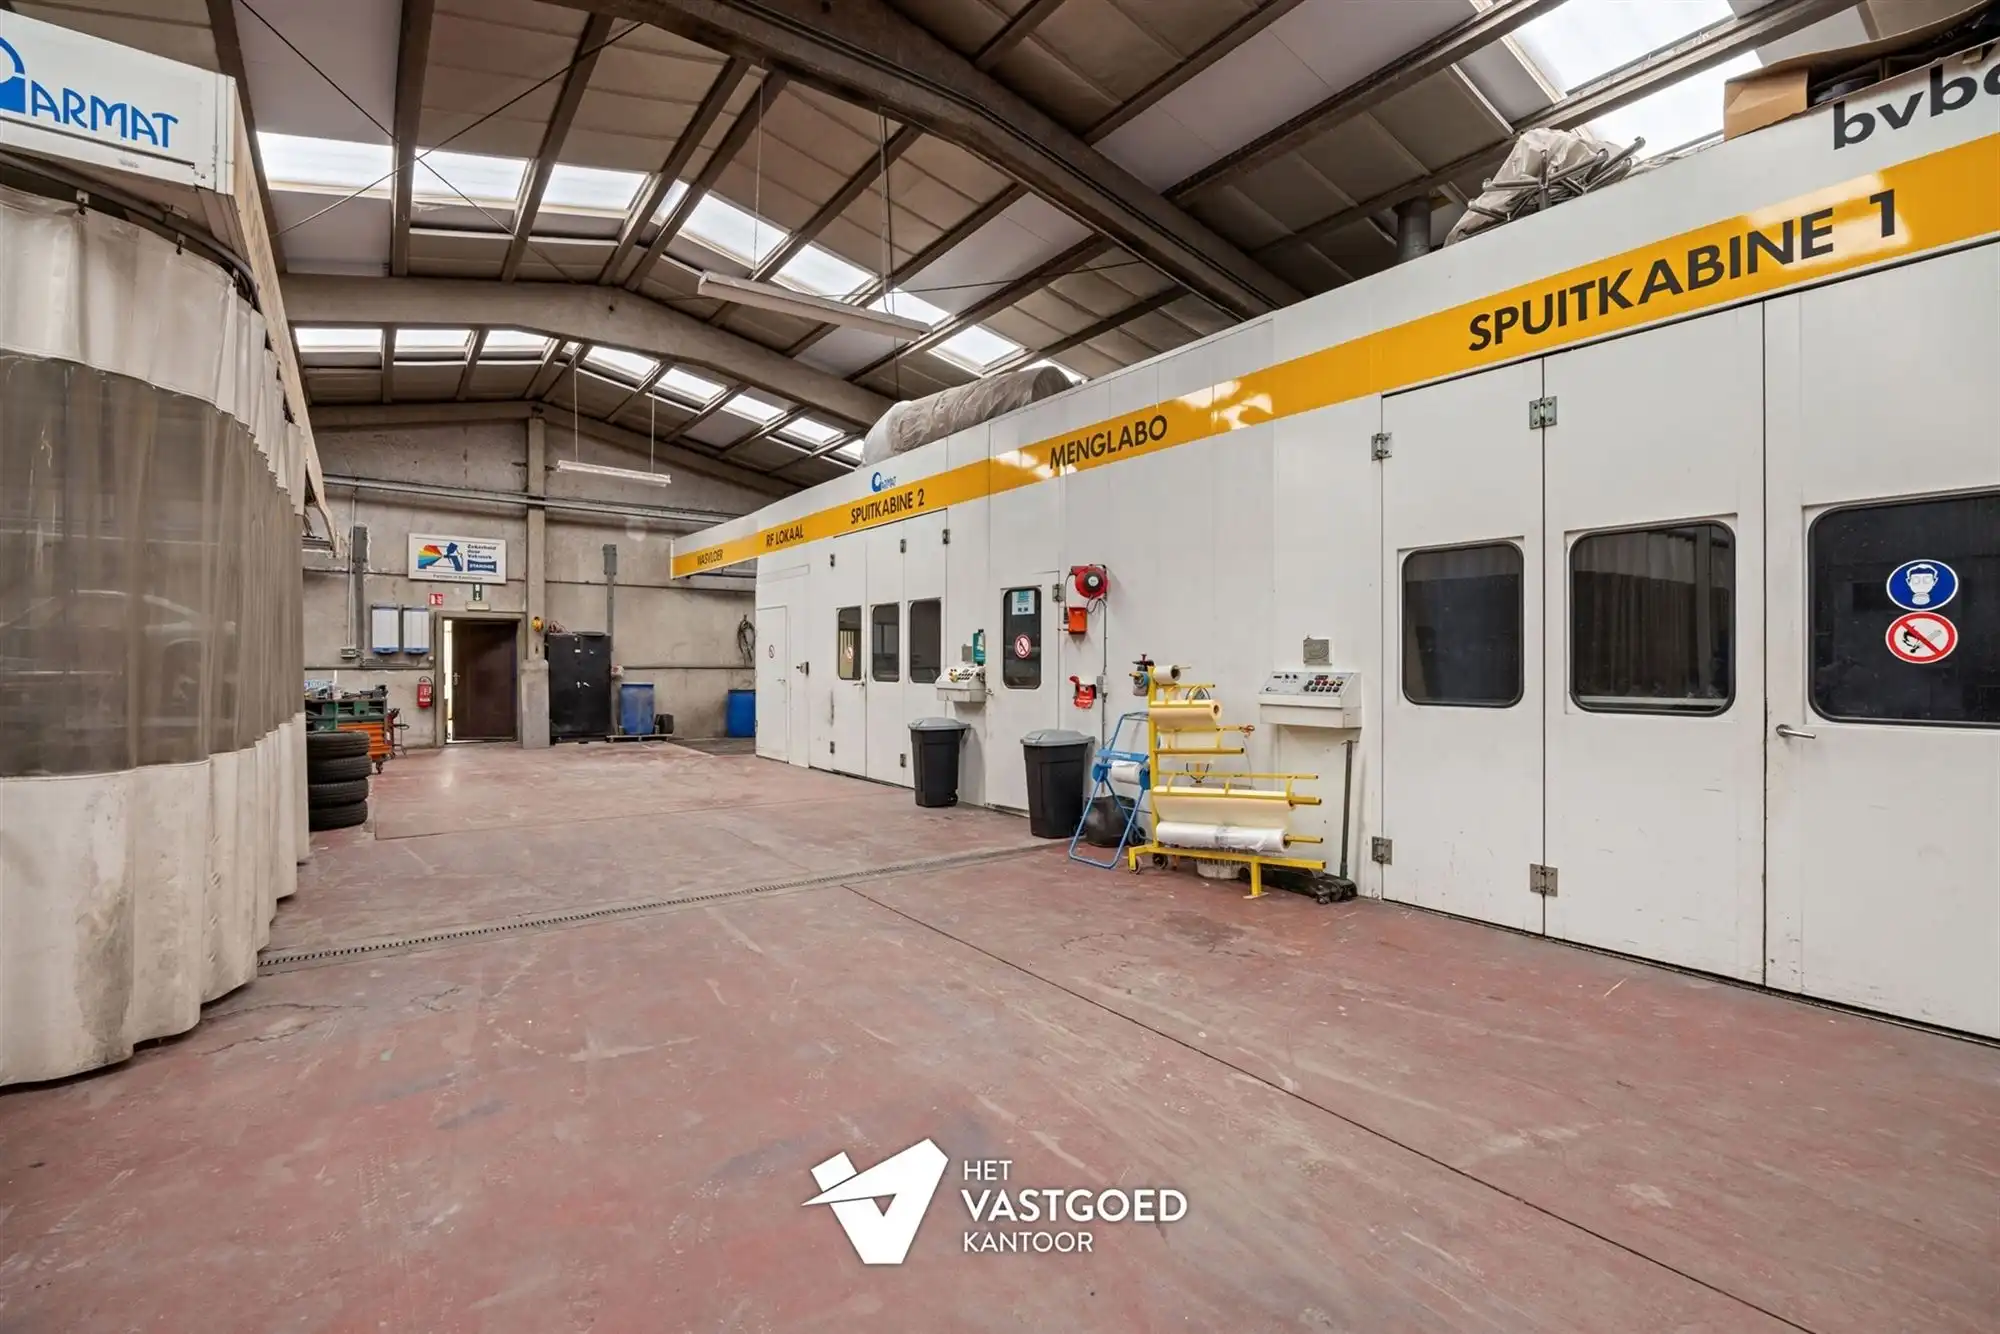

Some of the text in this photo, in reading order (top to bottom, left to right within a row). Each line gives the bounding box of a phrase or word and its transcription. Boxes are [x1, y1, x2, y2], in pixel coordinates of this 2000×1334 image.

[1468, 188, 1895, 352] SPUITKABINE 1
[1050, 414, 1168, 470] MENGLABO
[850, 487, 925, 525] SPUITKABINE 2
[775, 523, 804, 545] LOKAAL
